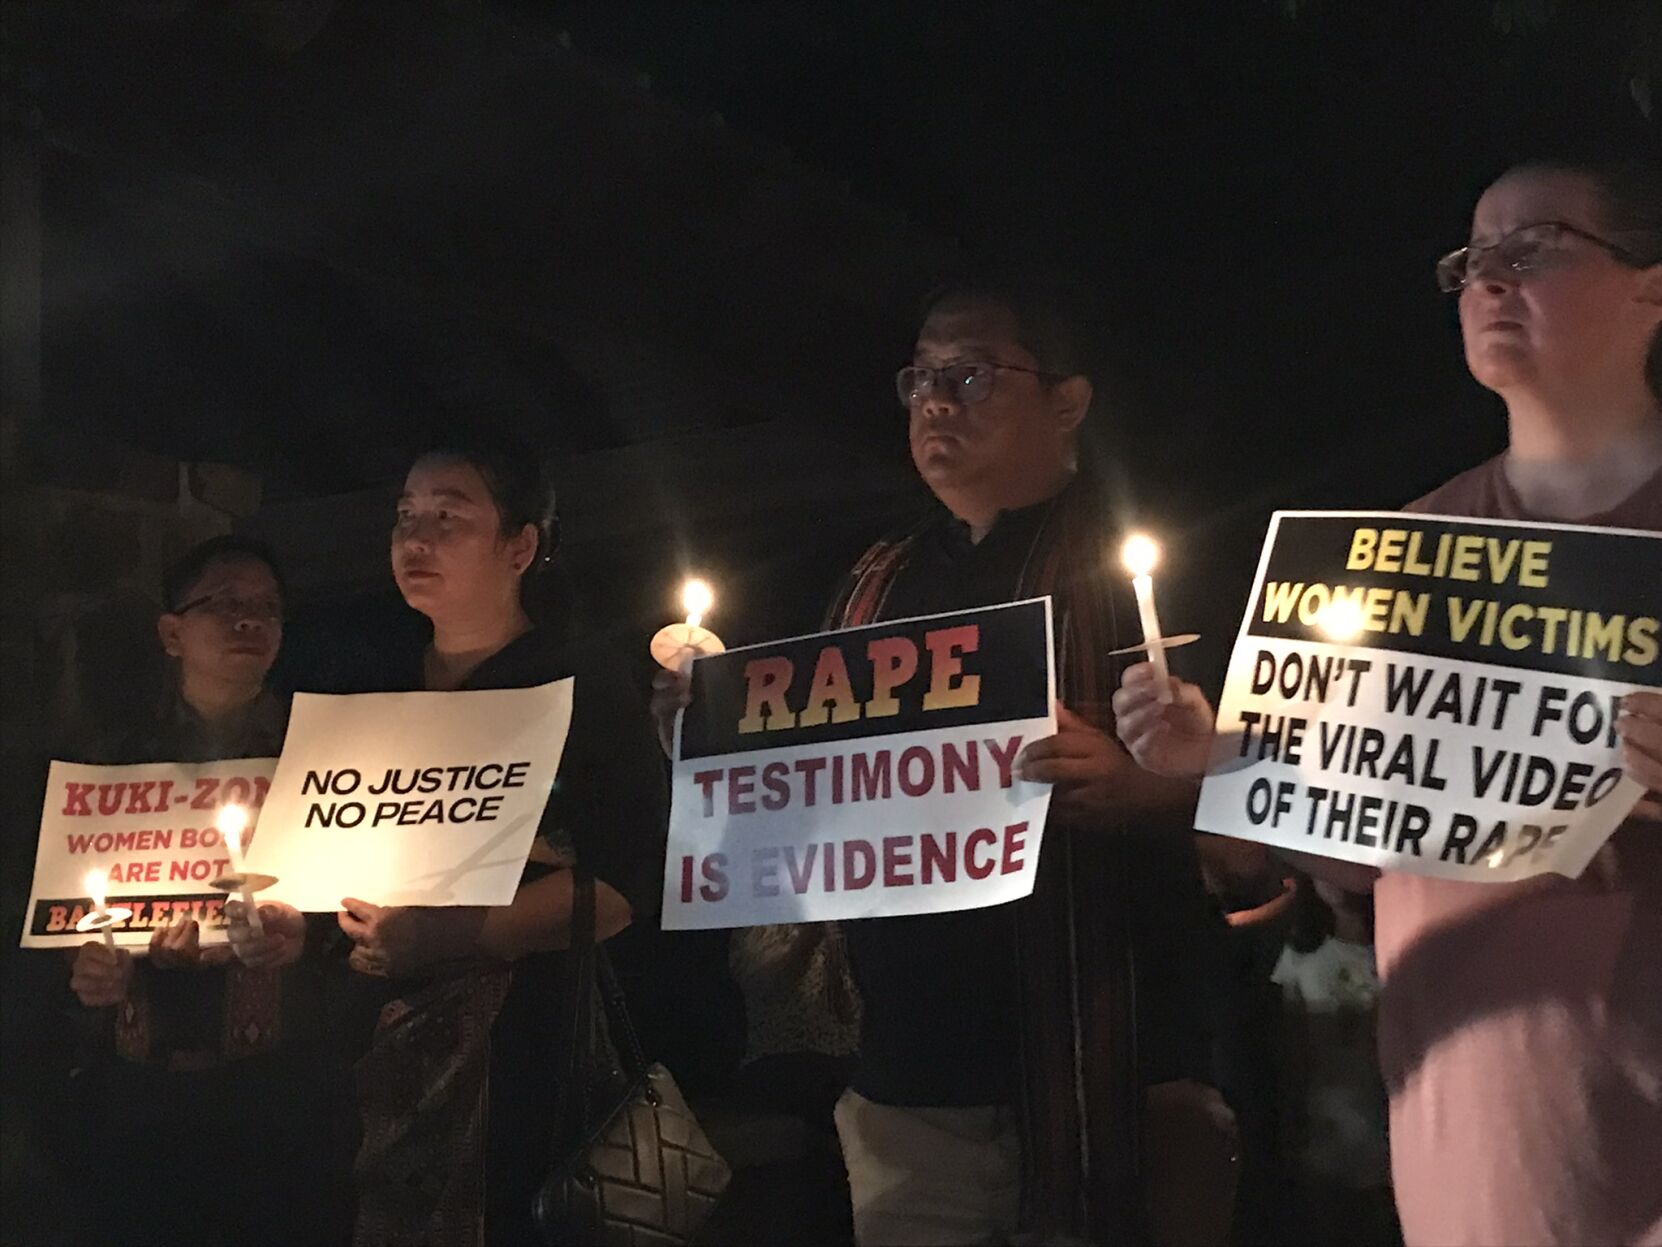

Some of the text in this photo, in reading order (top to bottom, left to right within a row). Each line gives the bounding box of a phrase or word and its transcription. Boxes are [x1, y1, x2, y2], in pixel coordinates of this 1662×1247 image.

[1346, 528, 1553, 588] BELIEVE
[1447, 596, 1661, 666] VICTIMS
[738, 625, 981, 734] RAPE
[1250, 649, 1371, 707] DON'T
[1385, 663, 1521, 730] WAIT
[301, 762, 530, 795] NO JUSTICE
[693, 735, 1024, 818] TESTIMONY
[1239, 711, 1624, 811] THE VIRAL VIDEO
[67, 829, 172, 854] WOMEN
[305, 796, 504, 829] NO PEACE
[1246, 776, 1296, 828] OF
[1306, 786, 1431, 856] THEIR
[108, 859, 230, 883] ARE NOT
[680, 821, 1030, 903] IS EVIDENCE
